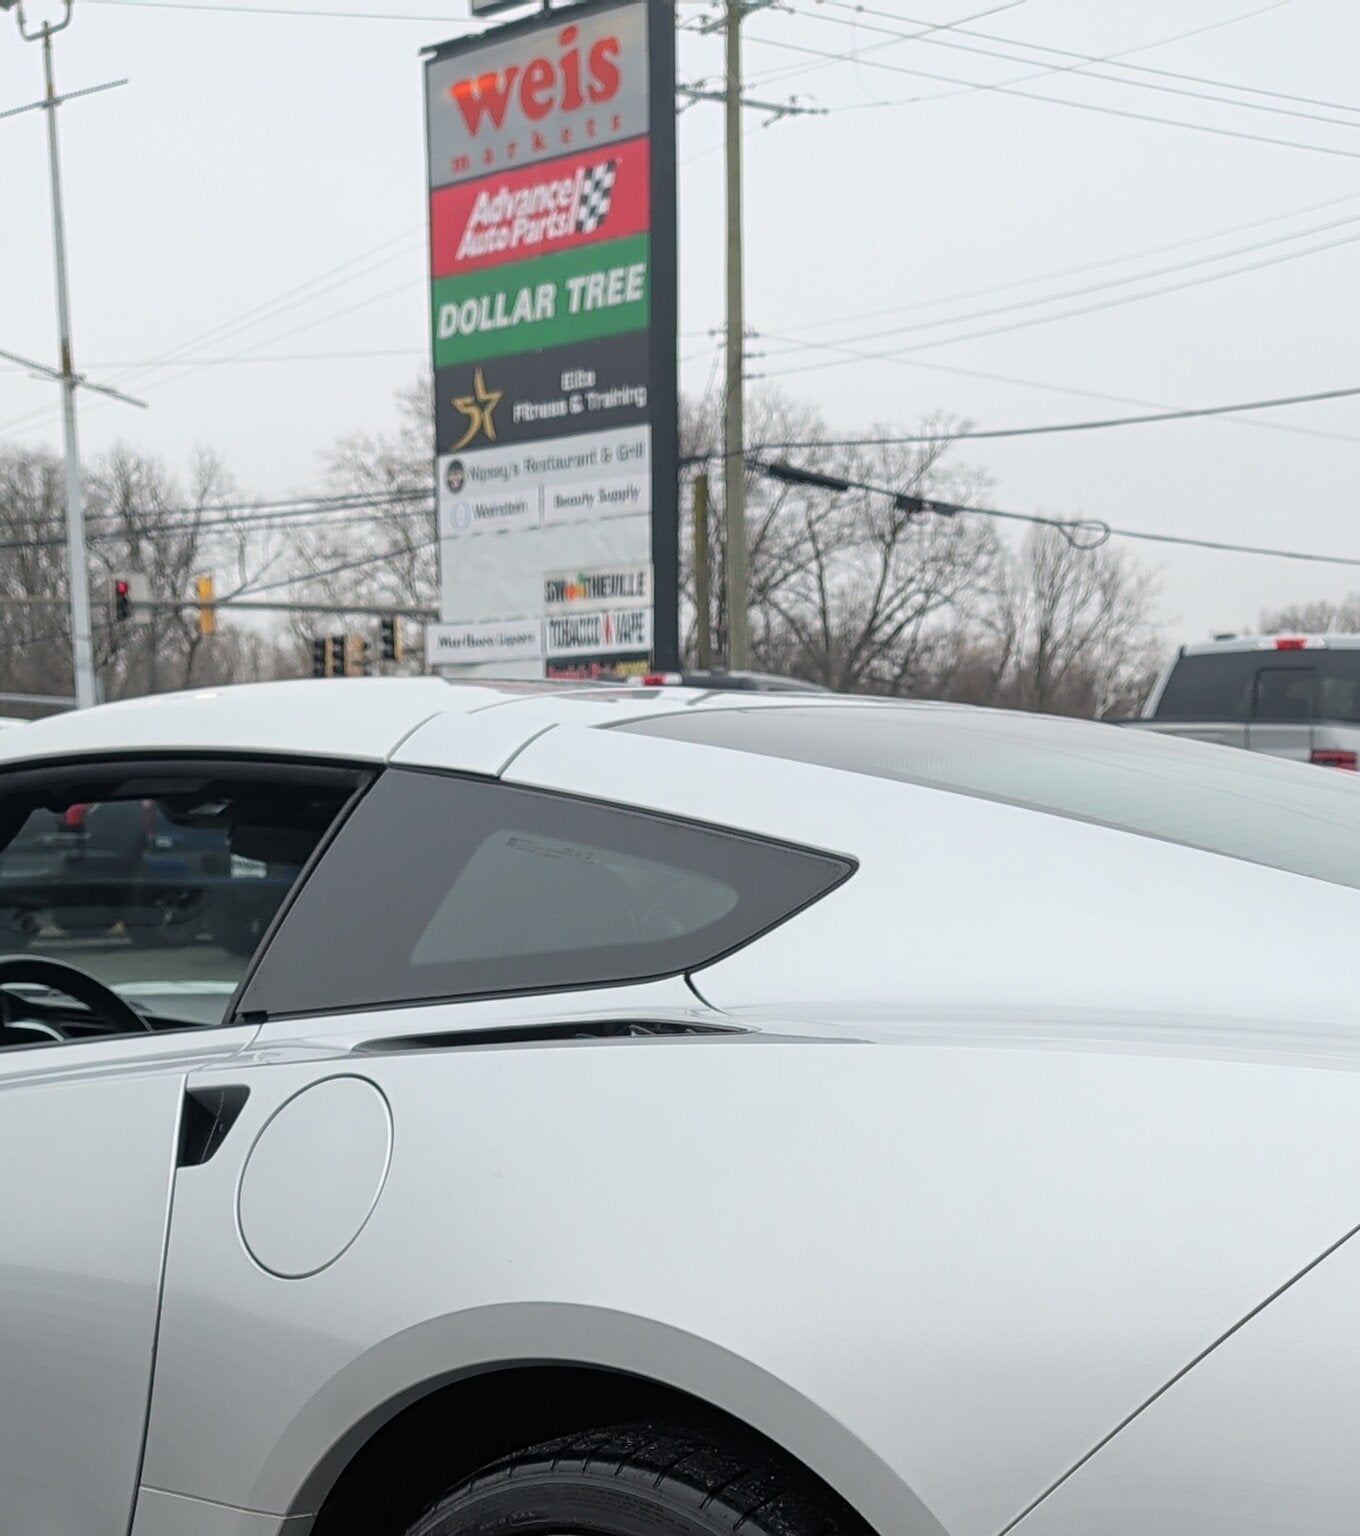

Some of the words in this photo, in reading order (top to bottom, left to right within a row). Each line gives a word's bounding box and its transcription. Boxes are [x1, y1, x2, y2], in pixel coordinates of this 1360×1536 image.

[450, 25, 620, 137] weis
[468, 178, 576, 224] Advance
[455, 224, 512, 260] Auto
[510, 211, 576, 249] Parts
[440, 283, 557, 339] DOLLAR
[566, 263, 647, 314] TREE
[569, 393, 584, 414] &
[584, 384, 647, 411] Training
